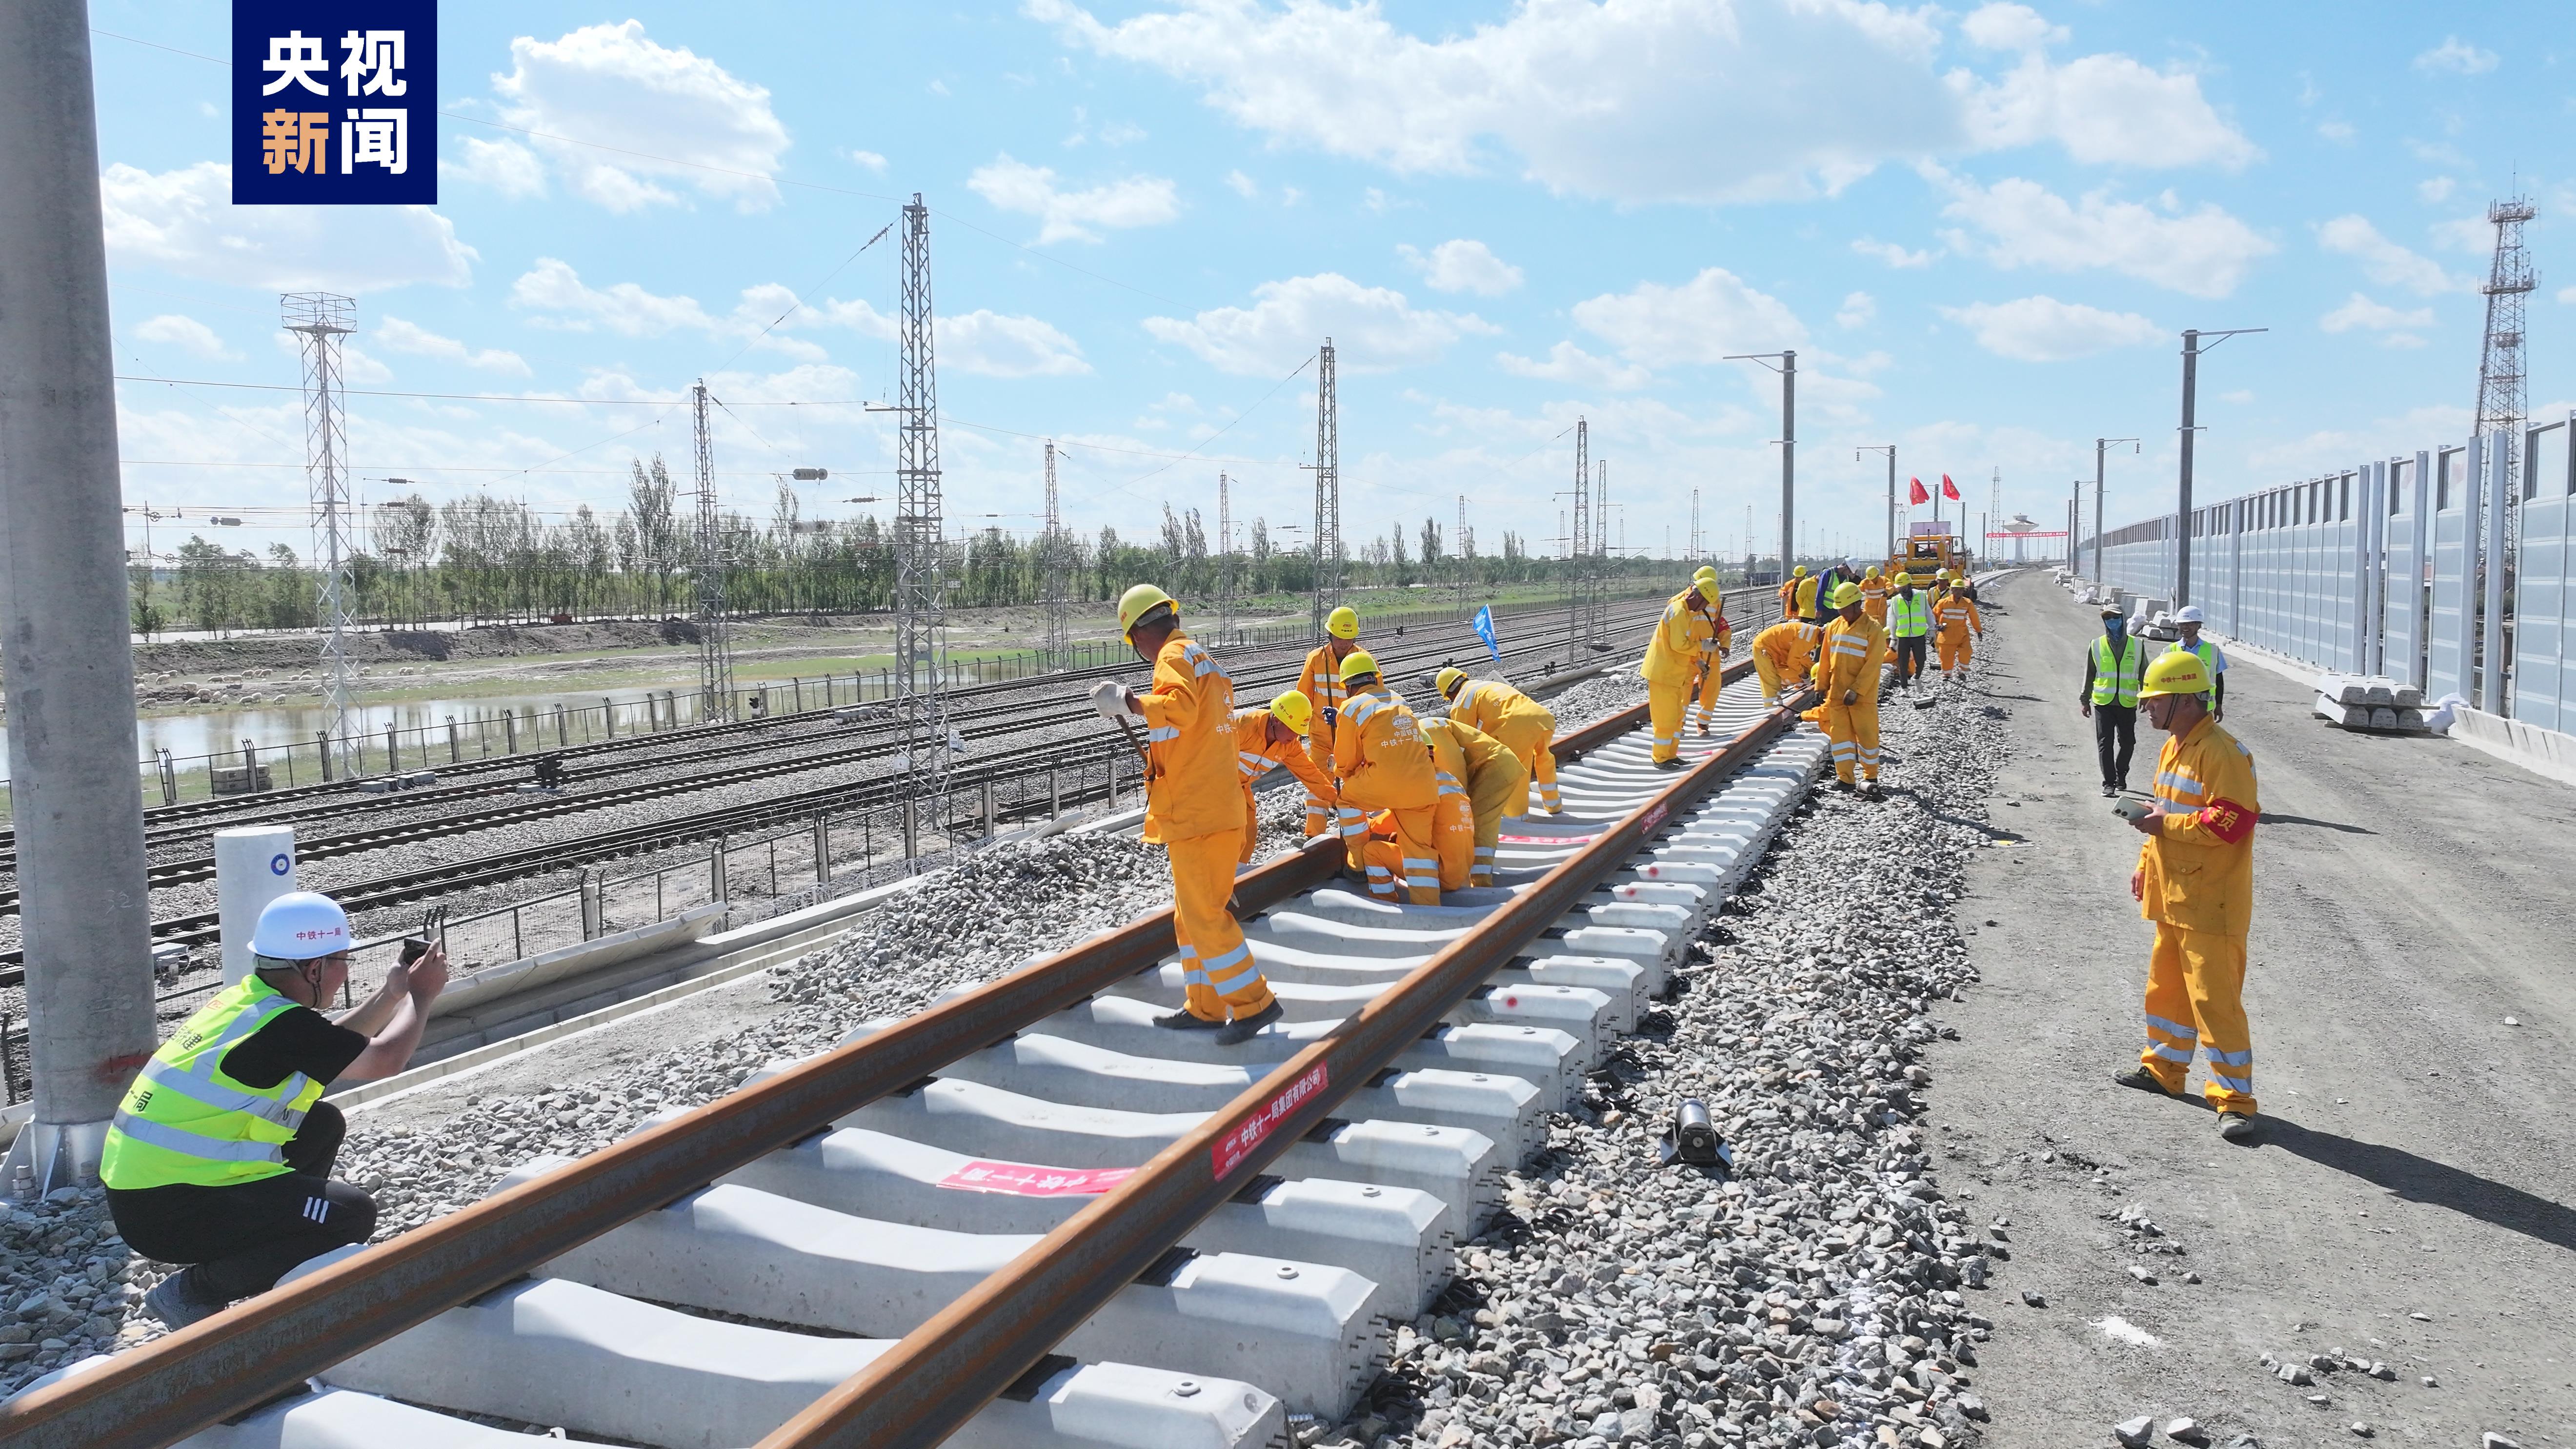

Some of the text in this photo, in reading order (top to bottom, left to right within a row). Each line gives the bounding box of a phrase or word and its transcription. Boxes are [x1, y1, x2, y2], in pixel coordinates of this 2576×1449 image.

[1394, 728, 1418, 738] 中国铁建
[296, 927, 342, 941] 中铁十一局
[1241, 1068, 1321, 1147] 中铁十一局集团有限公司
